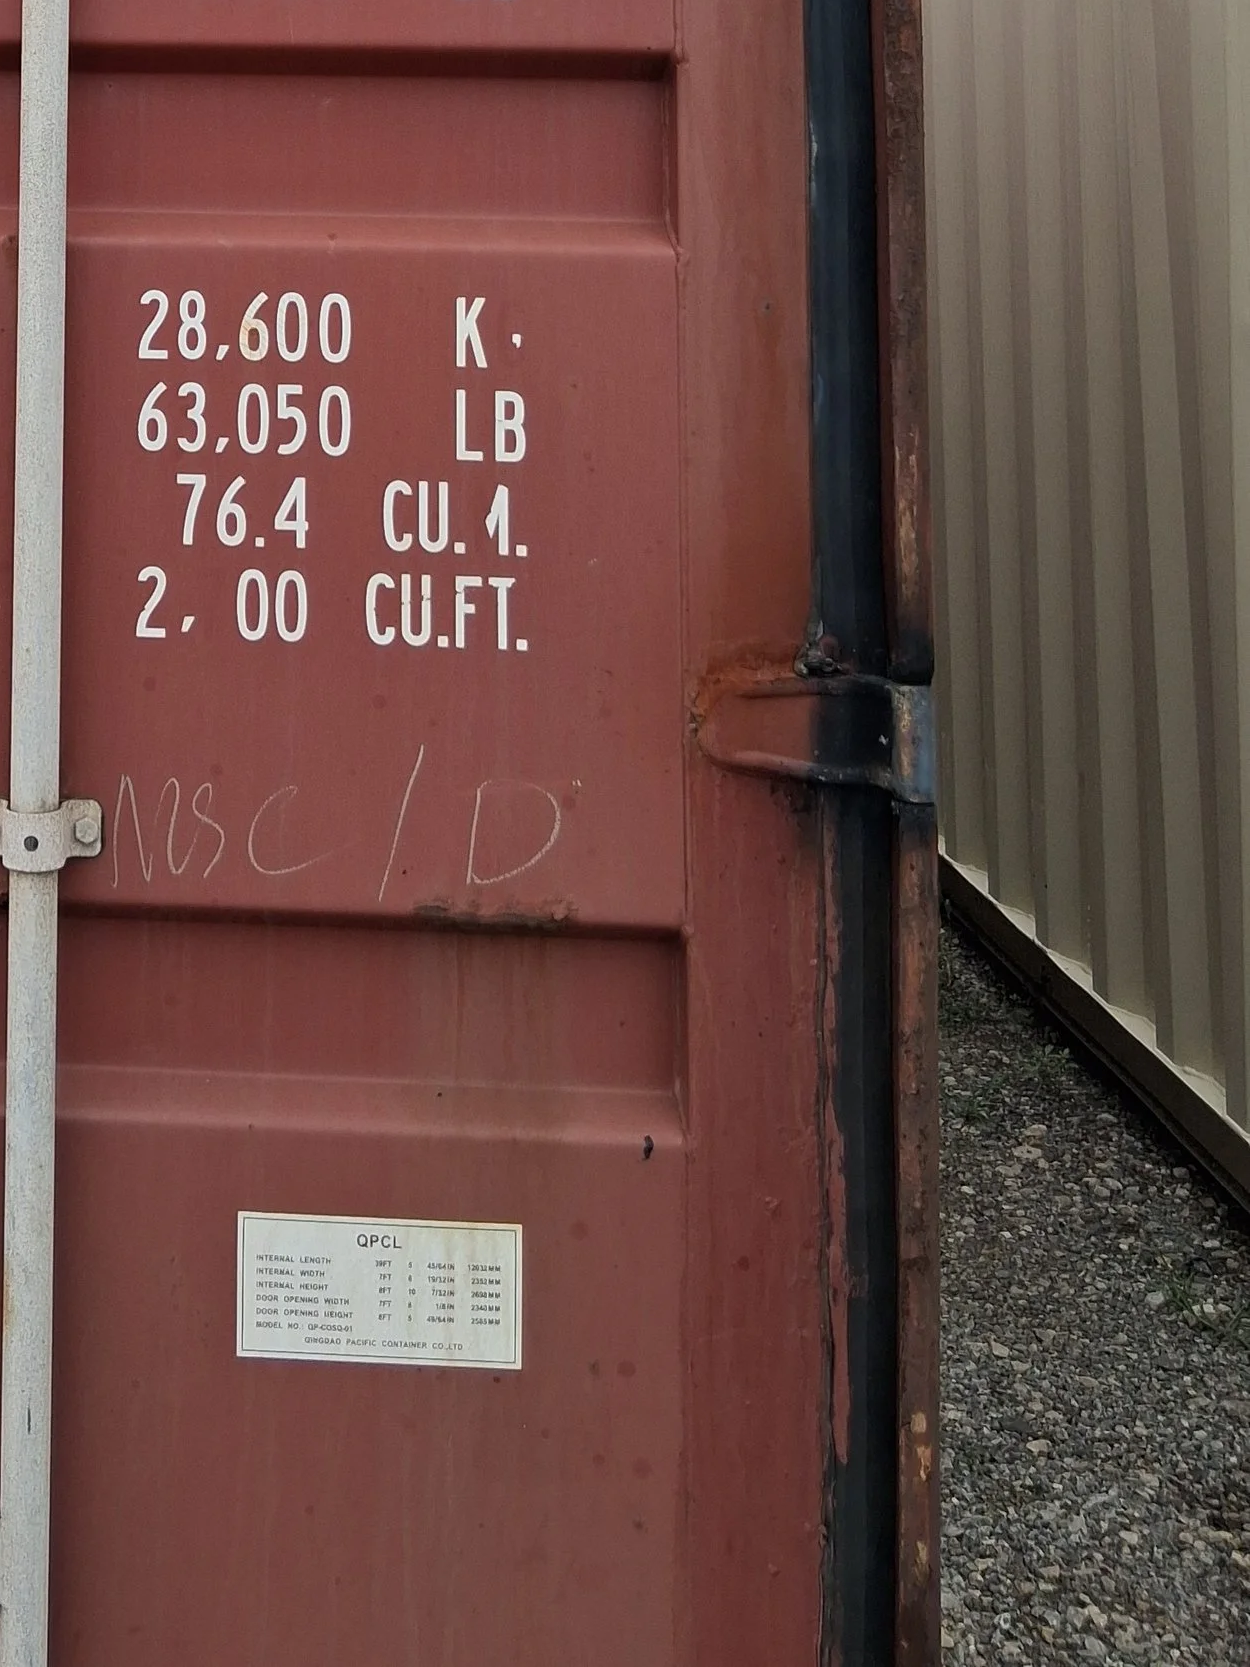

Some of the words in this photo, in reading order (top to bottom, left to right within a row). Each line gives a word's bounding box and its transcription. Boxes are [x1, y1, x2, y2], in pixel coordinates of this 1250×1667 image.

[139, 290, 351, 364] 28,600
[138, 382, 351, 457] 63,050
[456, 389, 526, 463] LB
[177, 474, 308, 548] 76.4
[366, 573, 528, 651] CU.FT.
[357, 1234, 402, 1250] QPCL
[256, 1254, 294, 1263] INTERNAL
[300, 1256, 331, 1265] LENGTH
[256, 1268, 294, 1277] INTERNAL
[300, 1270, 325, 1278] WIDTH
[256, 1281, 294, 1290] INTERNAL
[300, 1283, 328, 1291] HEIGHT
[256, 1294, 278, 1303] DOOR
[284, 1296, 319, 1305] OPENING
[324, 1298, 349, 1306] WIDTH
[256, 1308, 278, 1316] DOOR
[284, 1309, 319, 1318] OPENING
[324, 1311, 353, 1319] HEIGHT
[256, 1321, 283, 1330] MODEL
[305, 1337, 341, 1346] QINGDAO
[346, 1338, 376, 1347] PACIFIC
[382, 1340, 427, 1349] CONTAINER
